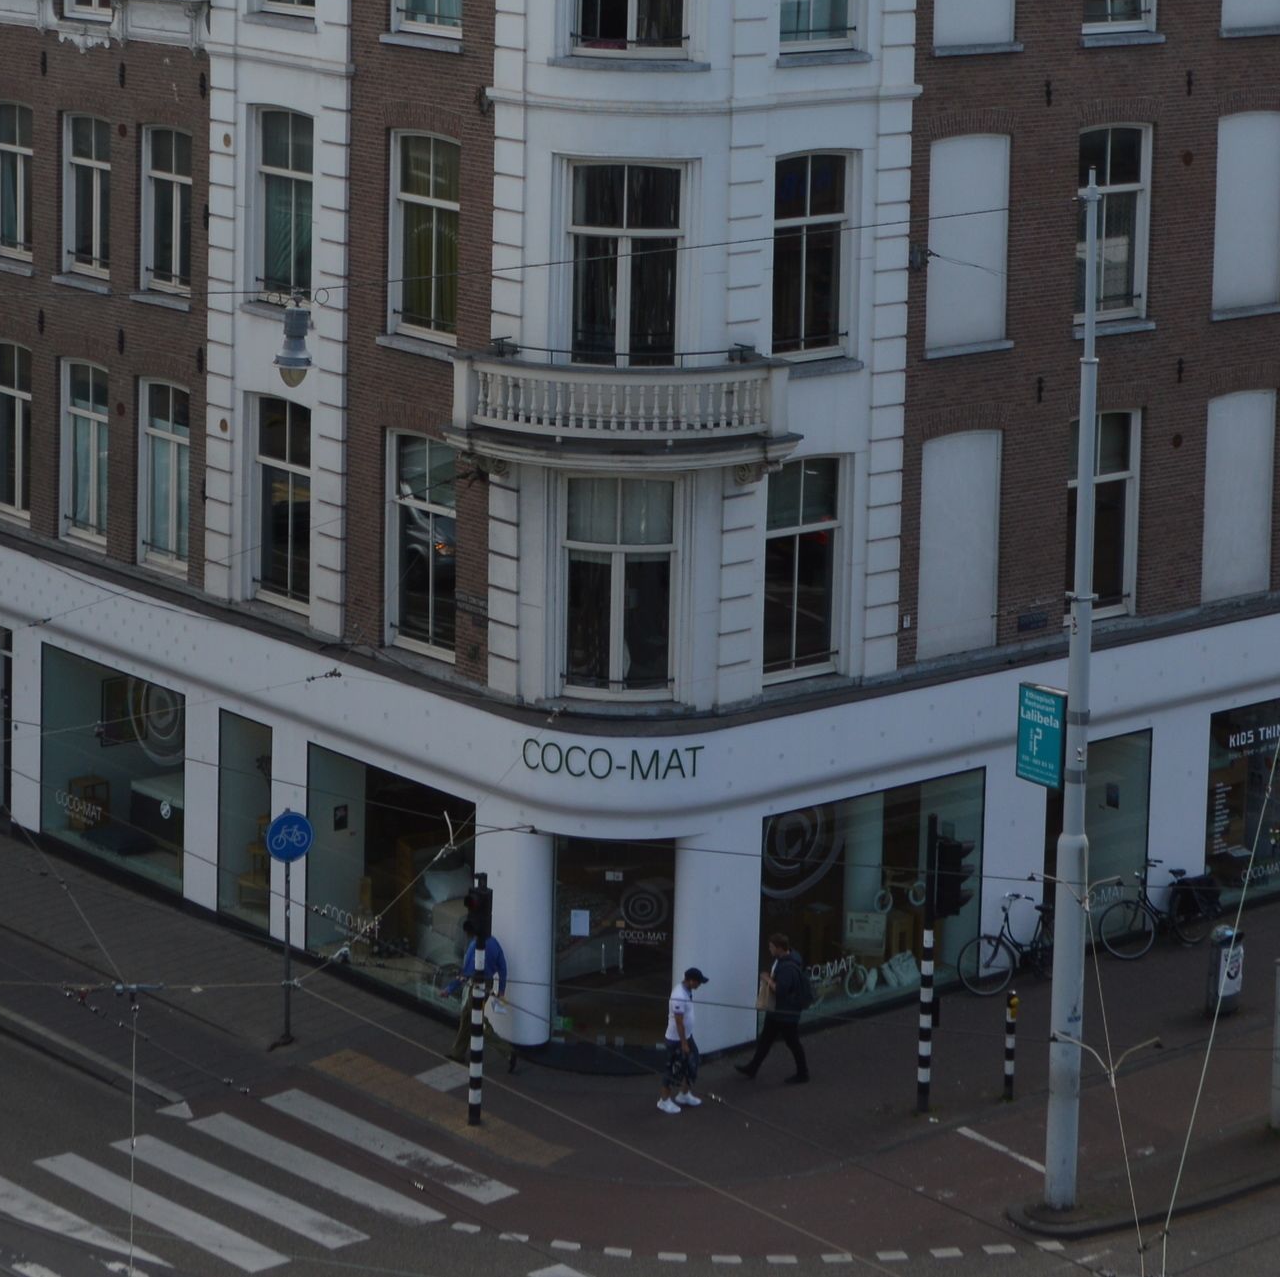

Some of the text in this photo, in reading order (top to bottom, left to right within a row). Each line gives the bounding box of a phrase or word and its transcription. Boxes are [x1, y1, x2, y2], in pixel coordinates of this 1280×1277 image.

[1020, 706, 1060, 729] Lalibela
[1229, 729, 1254, 749] KIDS
[522, 738, 705, 781] COCO-MAT
[55, 788, 103, 821] COCO-MAT
[618, 929, 668, 941] COCO-MAT
